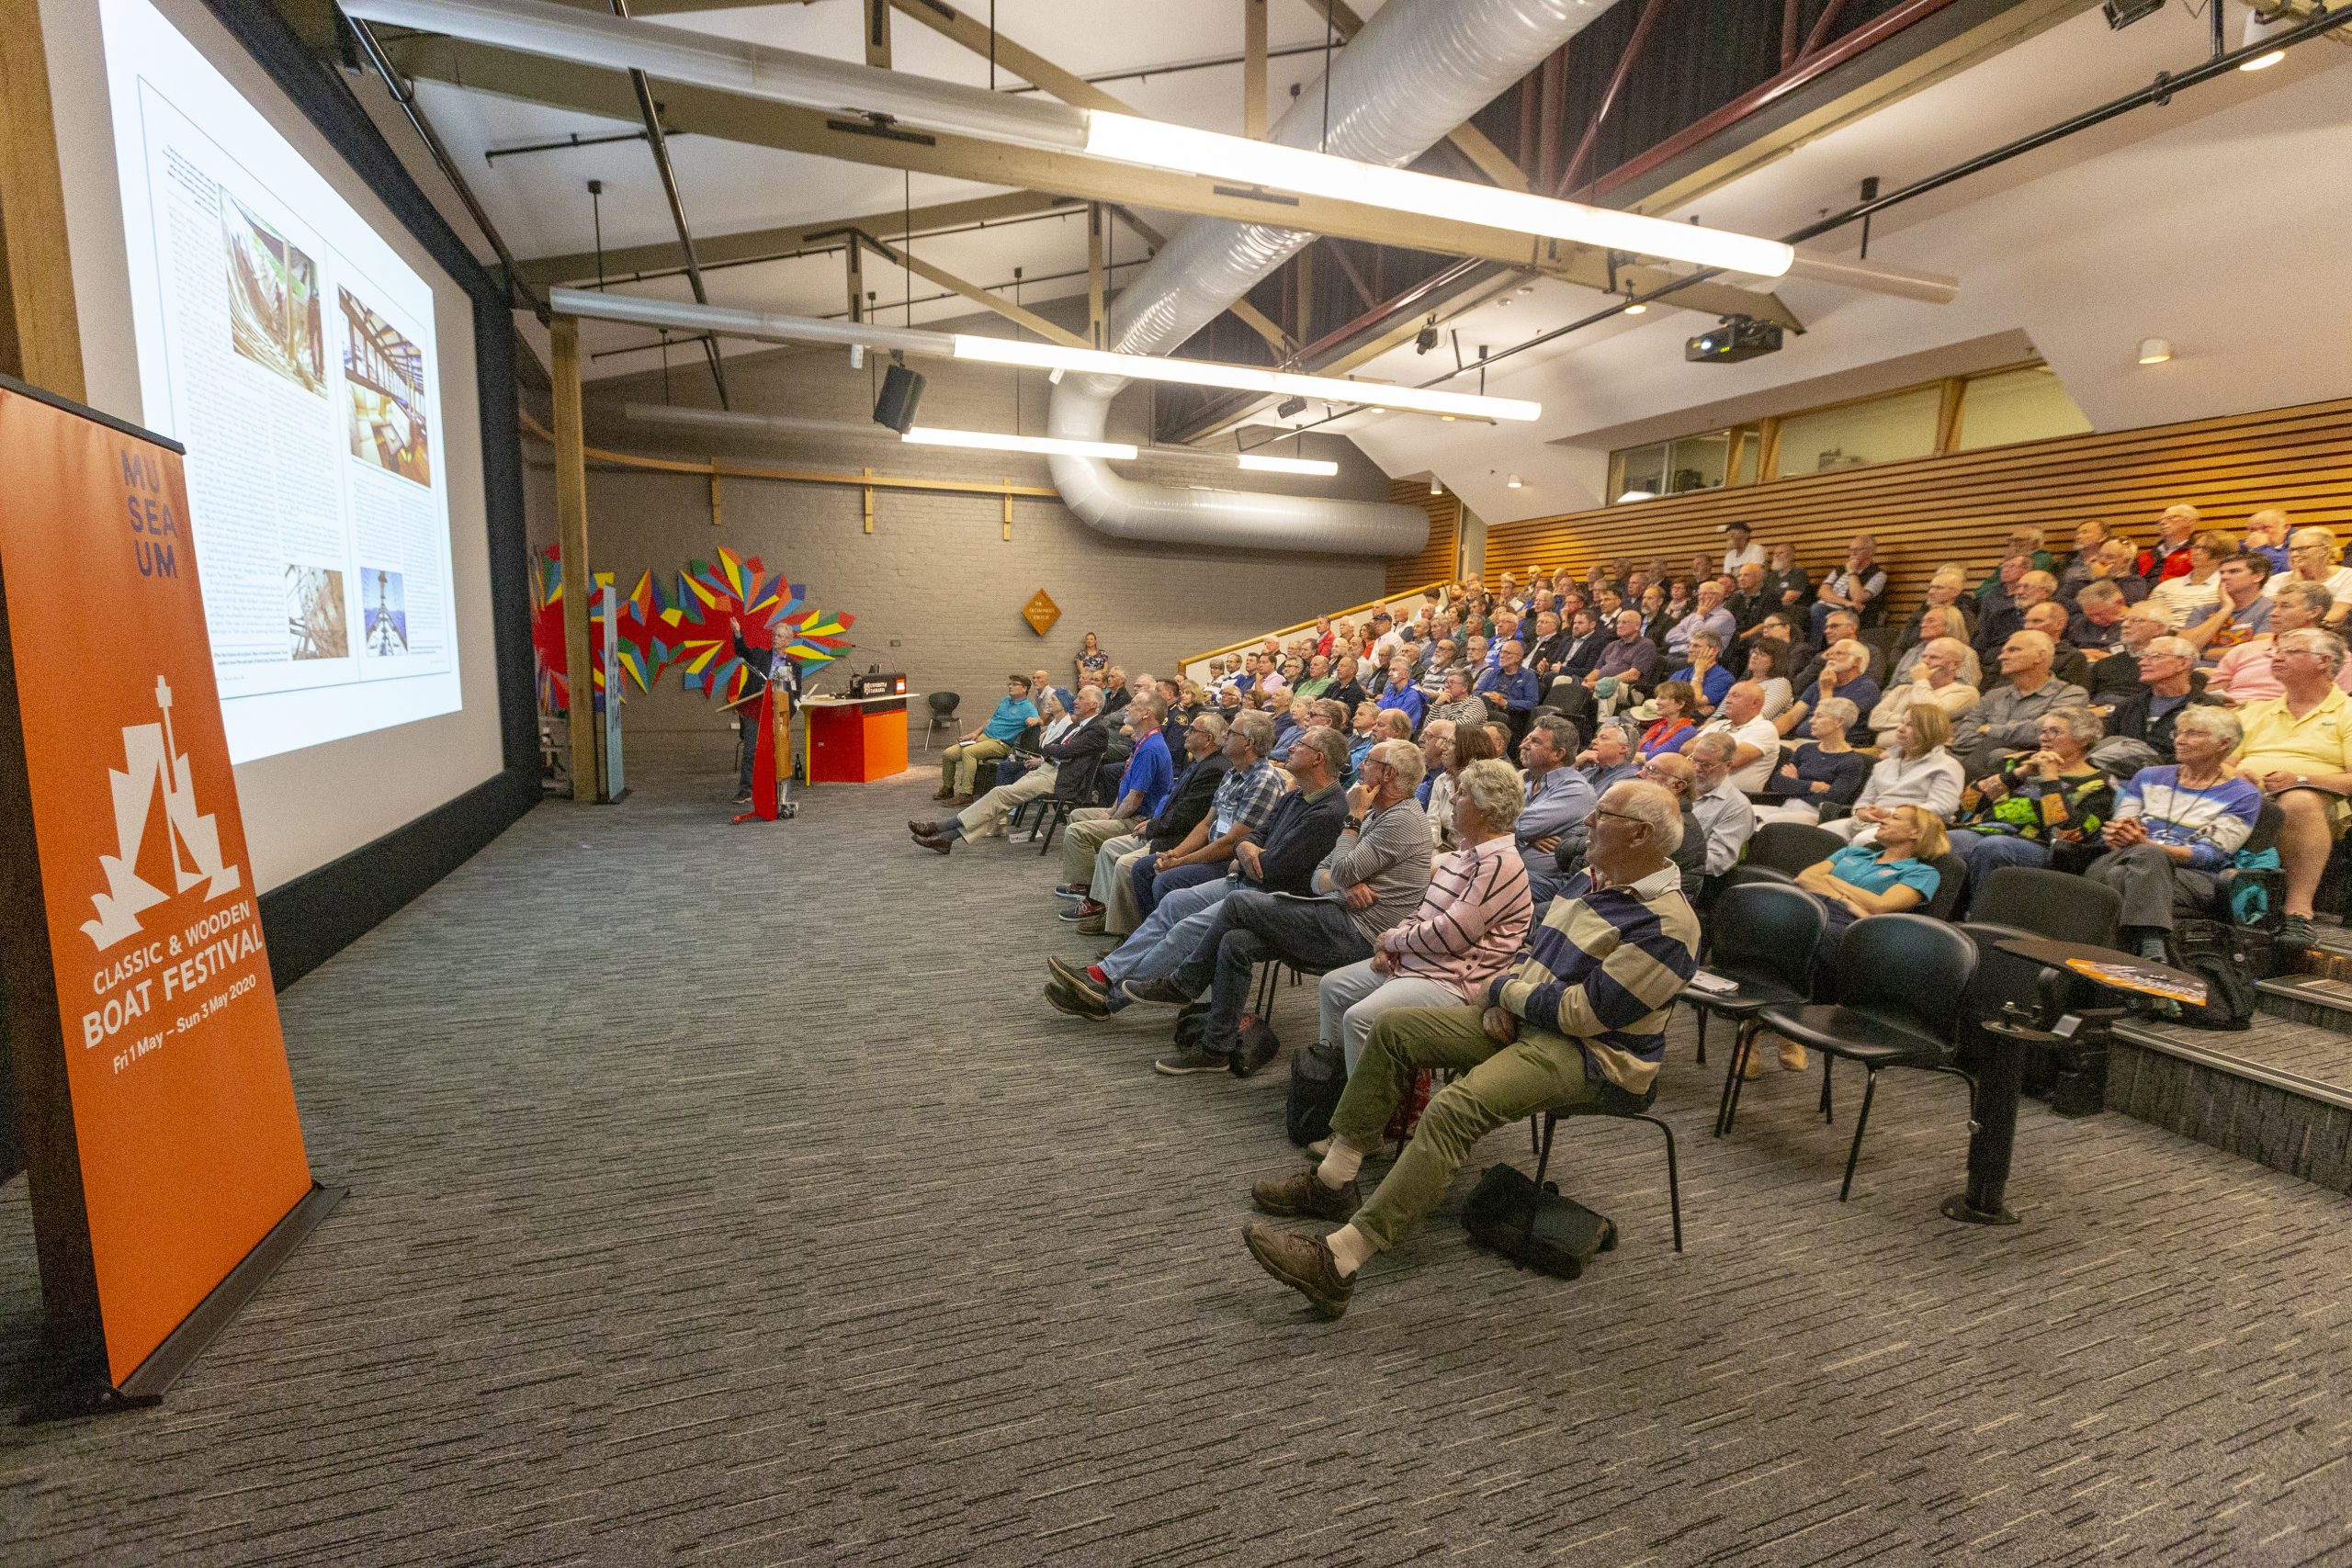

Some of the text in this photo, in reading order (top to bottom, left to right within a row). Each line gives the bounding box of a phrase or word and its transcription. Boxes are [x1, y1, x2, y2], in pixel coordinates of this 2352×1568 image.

[120, 449, 160, 493] MU
[128, 494, 177, 539] SEA
[134, 538, 177, 579] UM
[93, 900, 251, 995] CLASSIC & WOODEN
[83, 923, 264, 1049] BOAT FESTIVAL
[113, 1049, 129, 1075] Fri
[137, 1032, 164, 1057] May
[176, 1014, 200, 1033] Sun
[200, 1003, 209, 1019] 3
[209, 992, 229, 1014] May
[230, 974, 256, 1000] 2020
